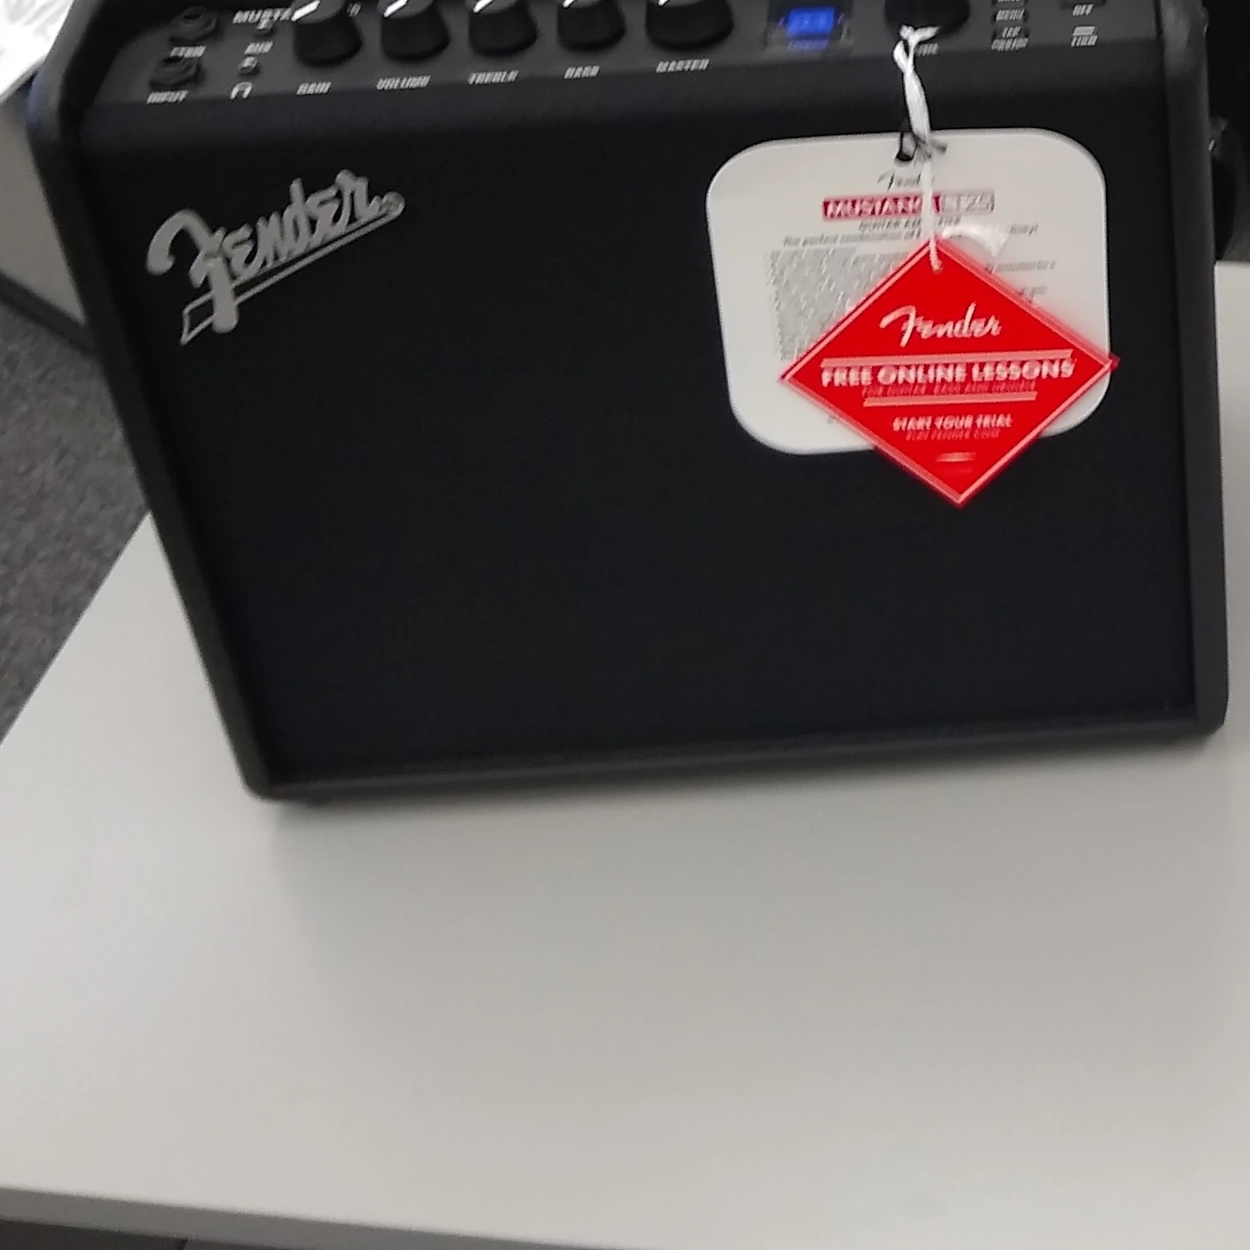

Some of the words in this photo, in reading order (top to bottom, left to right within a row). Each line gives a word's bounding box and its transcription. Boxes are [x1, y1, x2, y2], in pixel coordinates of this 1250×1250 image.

[656, 58, 711, 73] MASTER
[468, 70, 519, 85] TREBLE
[147, 89, 189, 104] INPUT
[876, 171, 934, 192] Fend
[824, 196, 934, 219] MUSTAN
[146, 168, 406, 346] Fender
[879, 301, 1002, 348] Fender
[821, 365, 873, 387] FREE
[877, 362, 967, 385] ONLINE
[972, 358, 1077, 382] LESSONS
[892, 415, 932, 432] START
[934, 413, 974, 430] YOUR
[976, 412, 1013, 429] TRIAL
